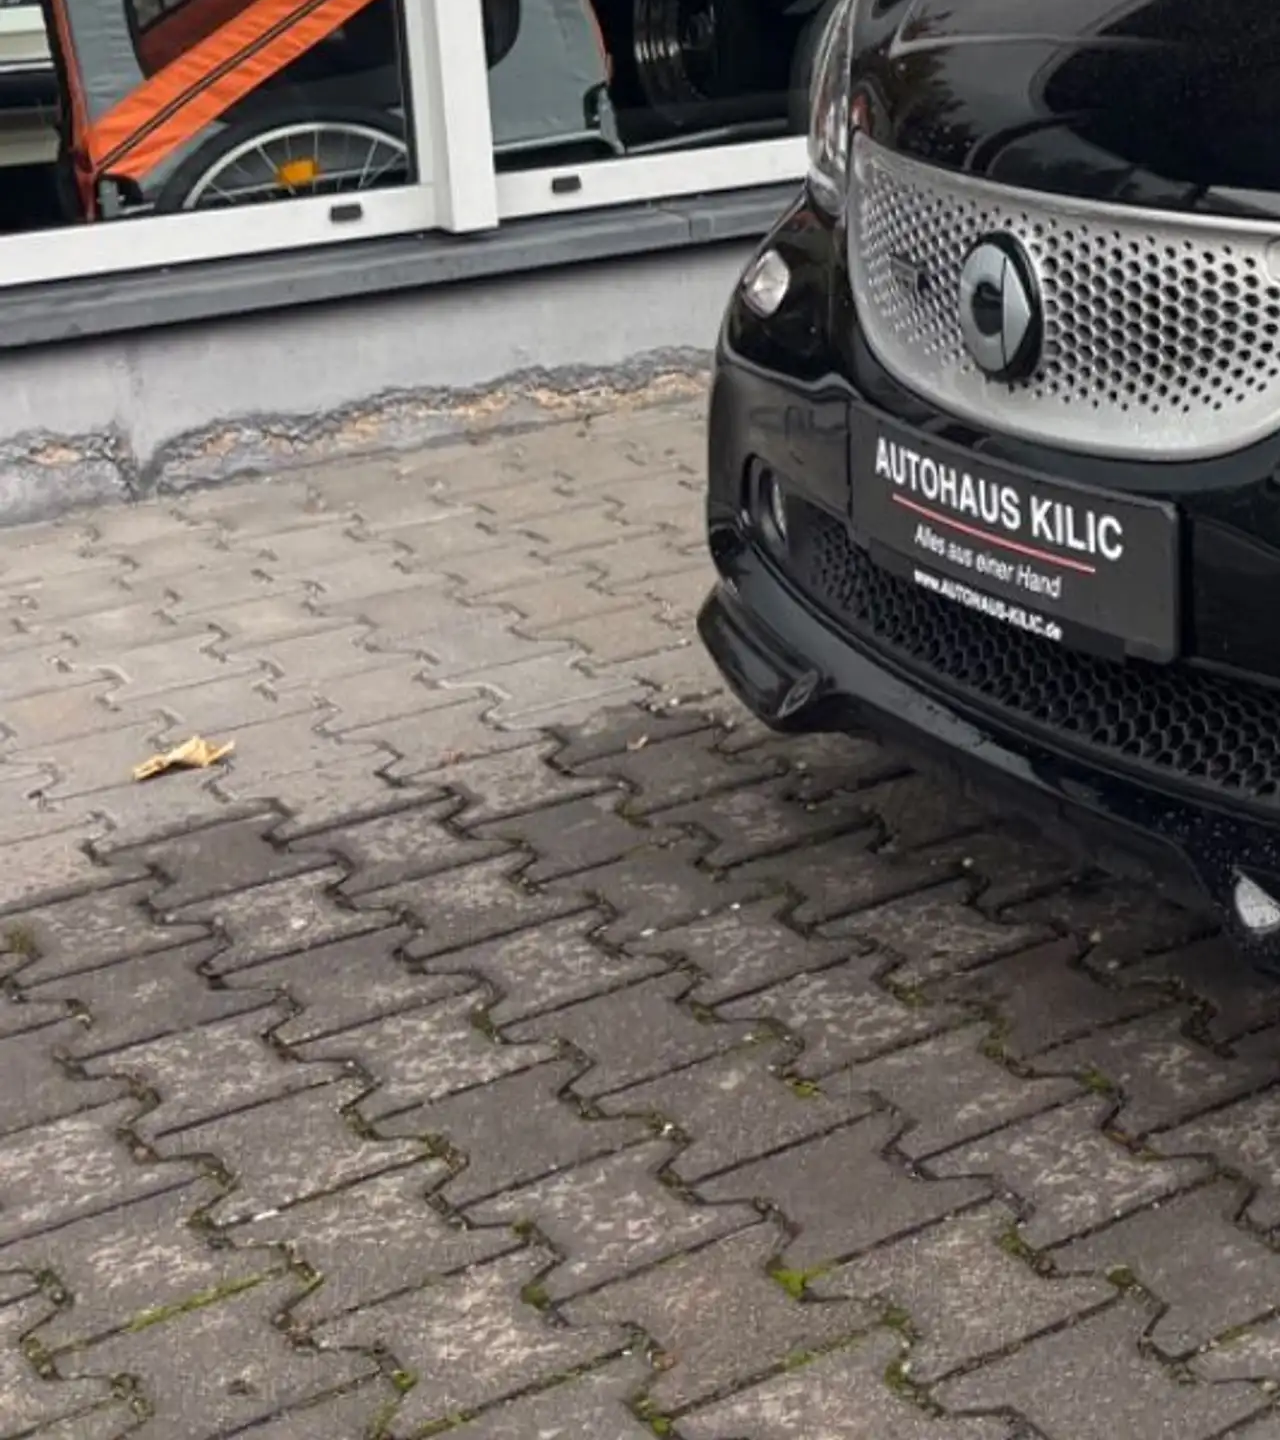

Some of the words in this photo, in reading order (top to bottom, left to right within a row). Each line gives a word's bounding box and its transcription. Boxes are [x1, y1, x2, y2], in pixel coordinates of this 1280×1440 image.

[875, 437, 1022, 531] AUTOHAUS
[1029, 495, 1124, 561] KILIC
[914, 525, 945, 557] Alles
[947, 542, 973, 568] aus
[976, 549, 1014, 581] einer
[1016, 563, 1062, 599] Hand
[913, 569, 1063, 642] www.AUTOHAUS-KILIC.de
